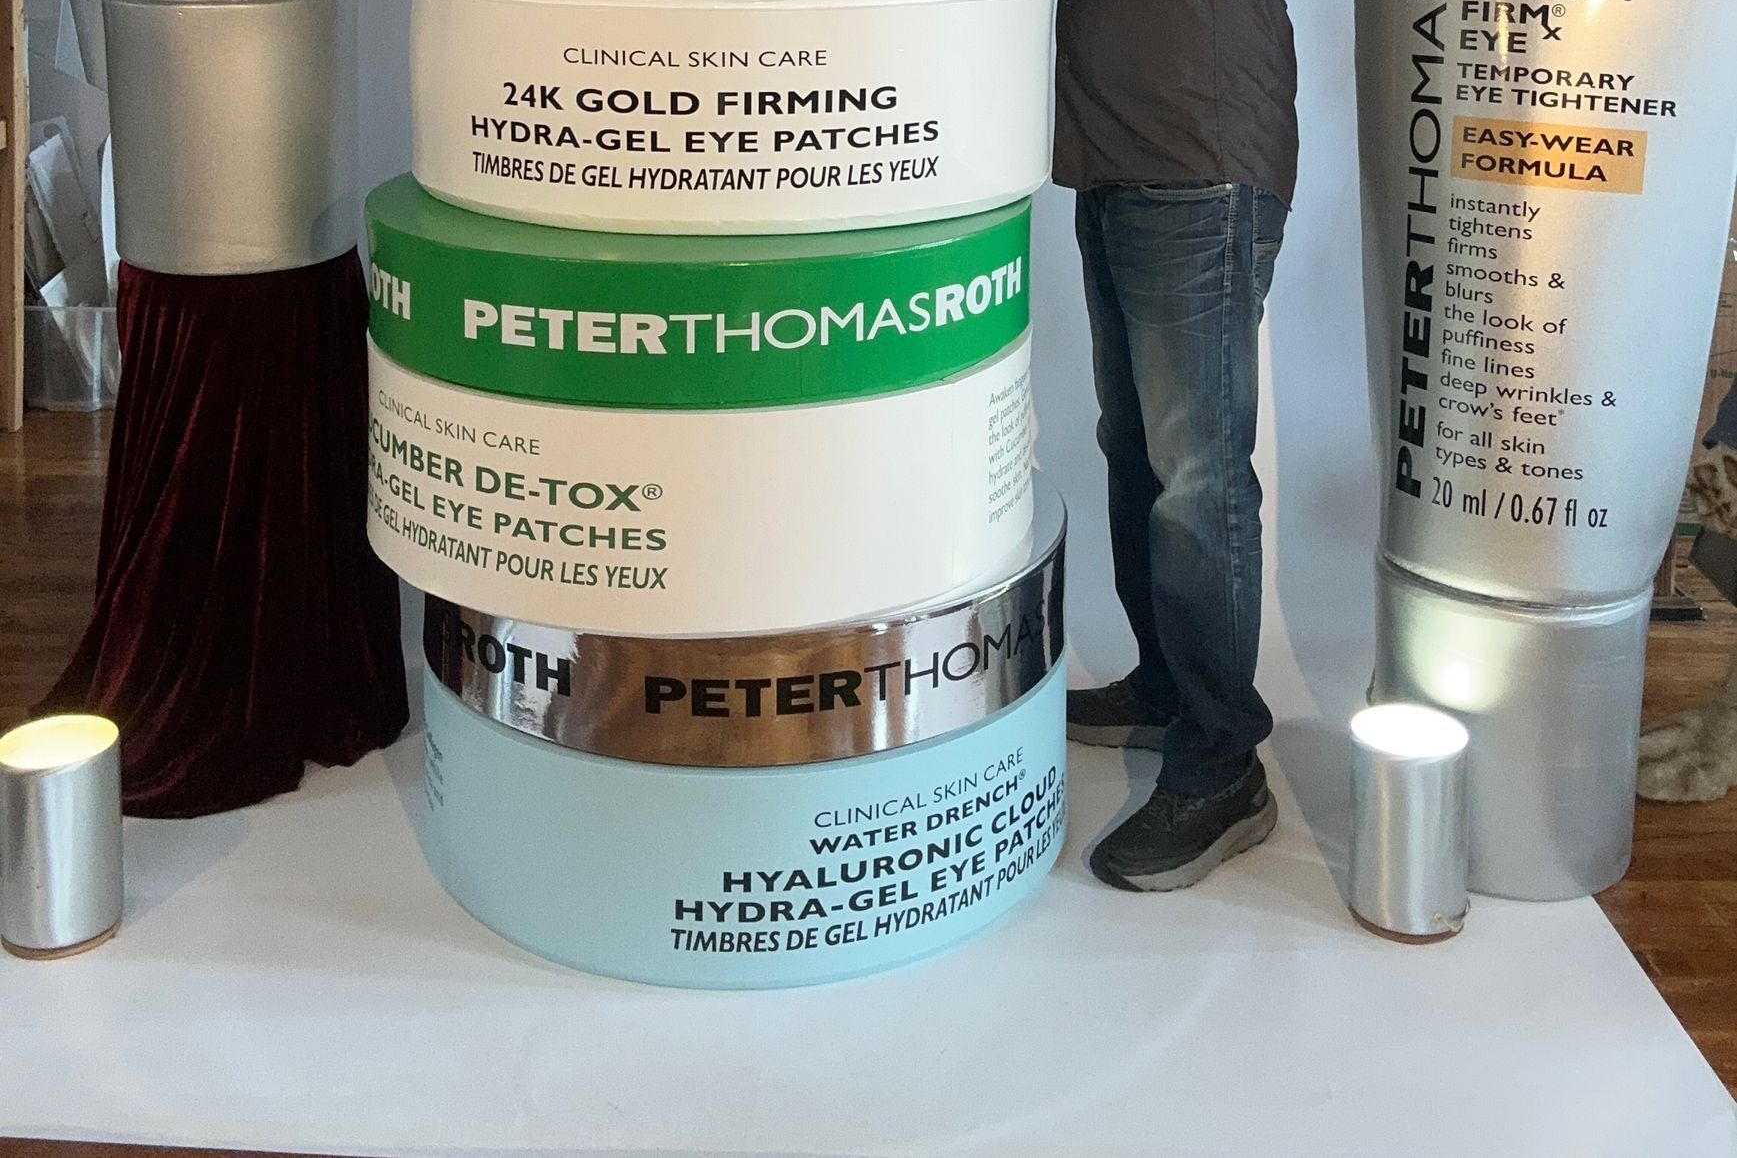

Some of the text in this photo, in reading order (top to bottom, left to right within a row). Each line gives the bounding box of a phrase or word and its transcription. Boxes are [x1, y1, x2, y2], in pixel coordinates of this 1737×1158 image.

[563, 47, 828, 68] CLINICAL SKIN CARE
[1459, 29, 1527, 54] EYE
[1457, 61, 1635, 91] TEMPORARY
[502, 81, 898, 116] 24K GOLD FIRMING
[1456, 84, 1677, 117] EYE TIGHTENER
[471, 115, 940, 154] HYDRA-GEL EYE PATCHES
[1463, 126, 1635, 156] EASY-WEAR
[472, 151, 940, 190] TIMBRES DE GEL HYDRATANT POUR LES YEUX
[1461, 153, 1608, 182] FORMULA
[1450, 193, 1541, 222] instantly
[1448, 215, 1533, 241] tightens
[1447, 238, 1498, 260] firms
[1445, 281, 1494, 304] blurs
[1446, 263, 1566, 290] smooths &
[463, 256, 1022, 356] PETERTHOMASROTH
[1444, 304, 1568, 335] the look of
[1442, 328, 1536, 355] puffiness
[1441, 348, 1536, 379] fine lines
[1440, 371, 1617, 408] deep wrinkles &
[378, 389, 541, 456] CLINICAL SKIN CARE
[1438, 394, 1504, 422] crow's
[1436, 420, 1546, 456] for all skin
[1435, 445, 1584, 480] types & tones
[1431, 476, 1453, 509] 20
[1462, 489, 1486, 517] ml
[1511, 493, 1558, 525] 0.67
[1565, 498, 1578, 527] fl
[1588, 508, 1608, 528] oz
[432, 494, 483, 530] EYE
[493, 512, 668, 551] PATCHES
[383, 504, 400, 534] GEL
[402, 516, 492, 570] HYDRATANT
[496, 550, 554, 581] POUR
[560, 562, 599, 587] LES
[605, 565, 669, 590] YEUX
[814, 746, 1024, 829] CLINICAL SKIN CARE
[723, 765, 1057, 894] HYALURONIC CLOUD
[809, 819, 918, 856] WATER
[670, 928, 780, 953] TIMBRES
[786, 927, 819, 951] DE
[824, 921, 869, 946] GEL
[874, 874, 996, 938] HYDRATANT
[997, 845, 1034, 890] POUR
[1036, 824, 1052, 860] LES
[675, 880, 919, 923] HYDRA-GEL
[930, 851, 986, 892] EYE
